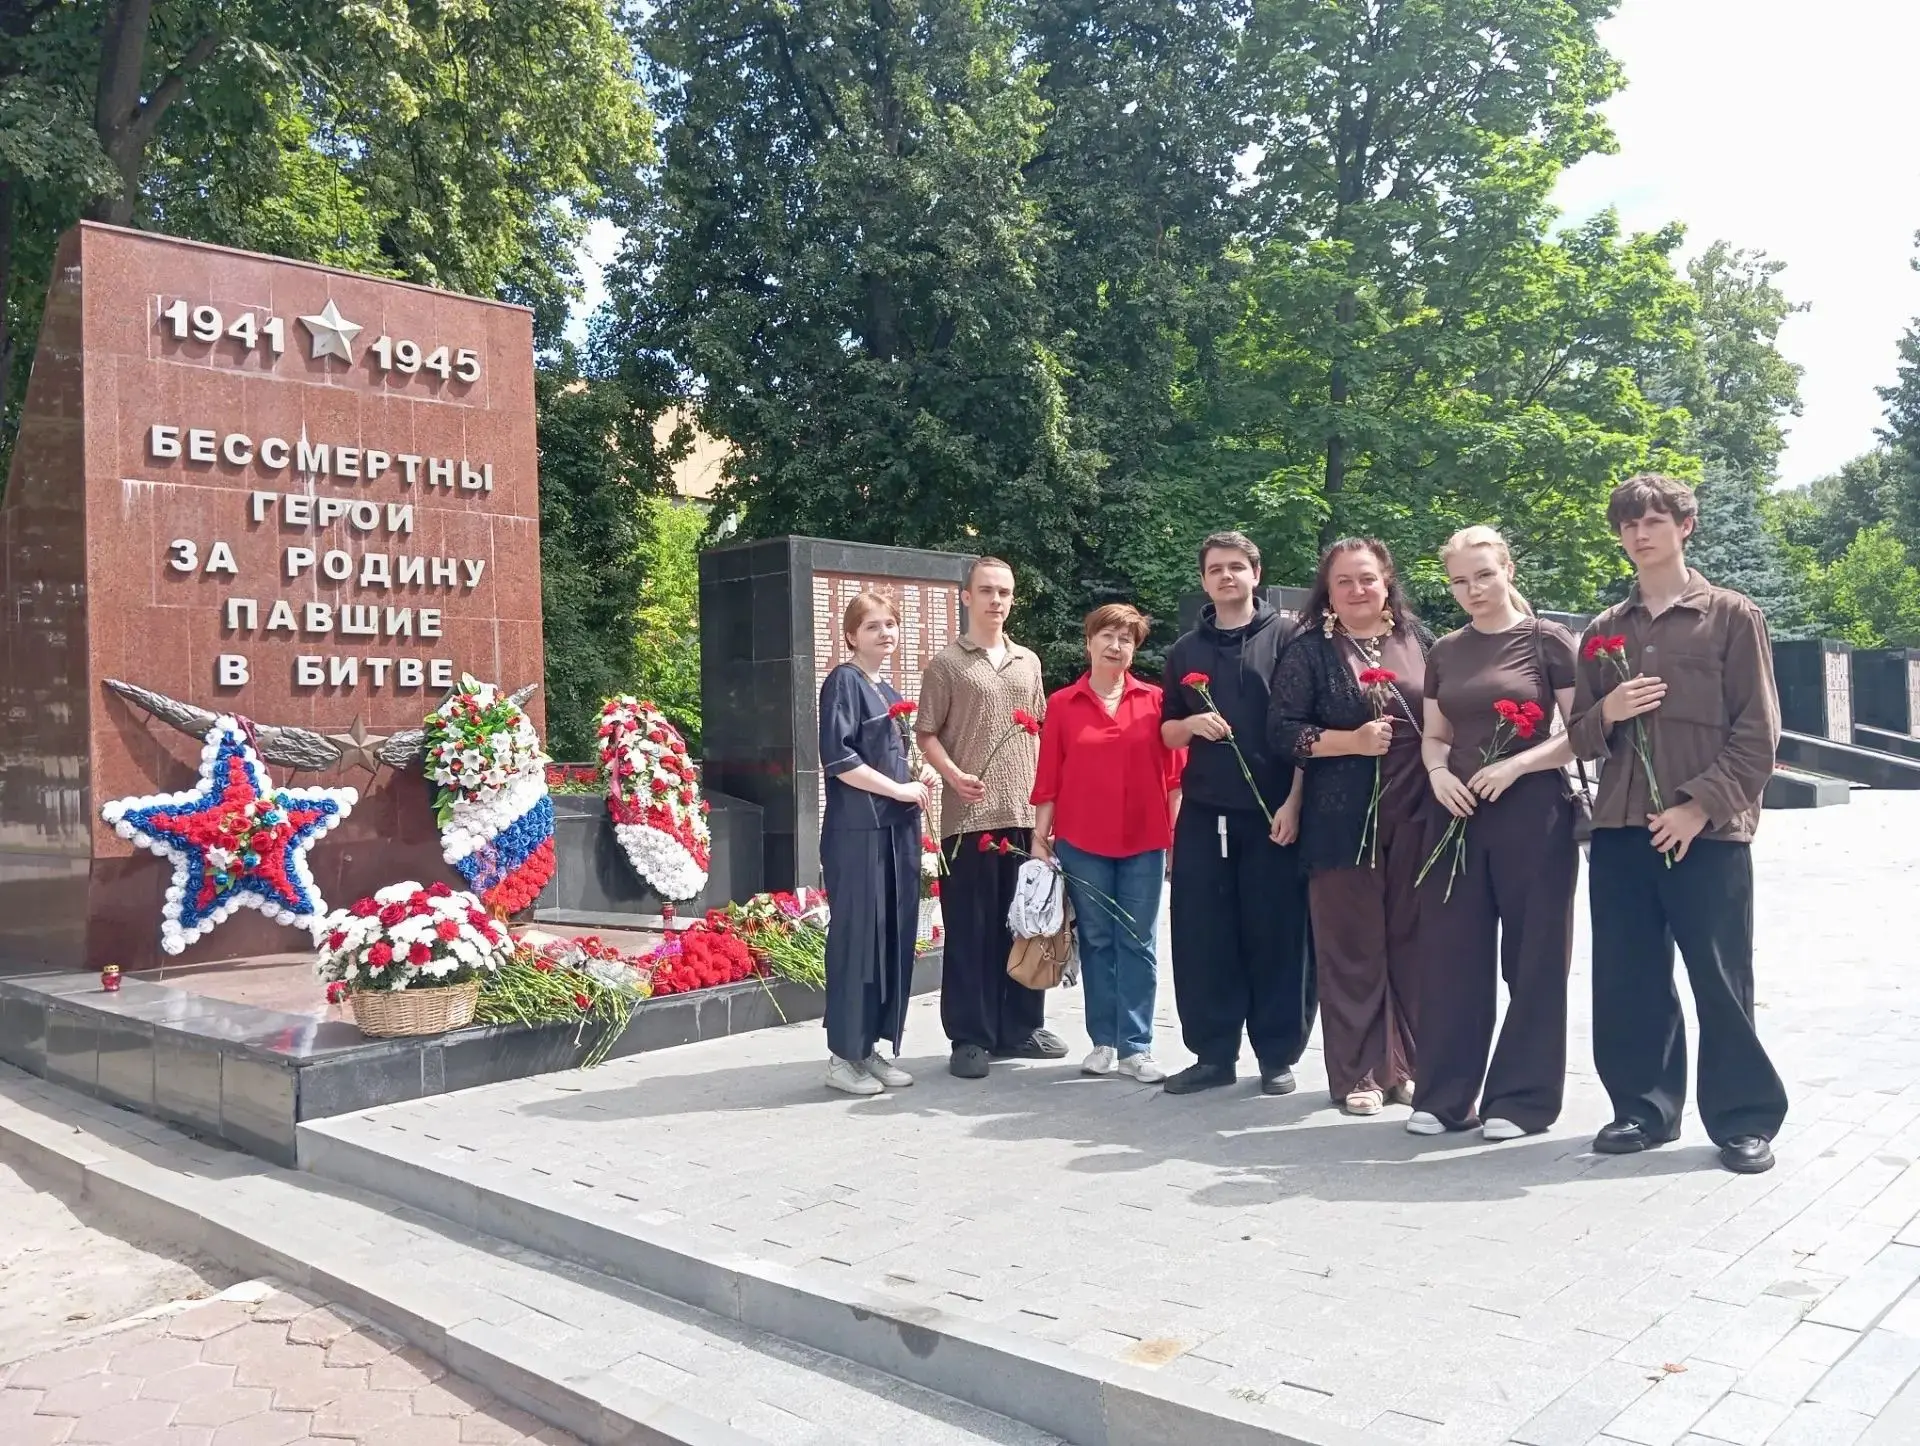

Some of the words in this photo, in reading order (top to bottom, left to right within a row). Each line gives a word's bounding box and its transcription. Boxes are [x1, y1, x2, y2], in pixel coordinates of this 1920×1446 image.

[164, 299, 286, 353] 1941
[371, 334, 482, 384] 1945
[150, 423, 494, 492] БЕССМЕРТНЫ
[251, 491, 415, 534] ГЕРОИ
[169, 538, 239, 575] ЗА
[287, 546, 486, 589] РОДИНУ
[226, 598, 443, 639] ПАВШИЕ
[219, 654, 250, 687] В
[297, 655, 454, 688] БИТВЕ
